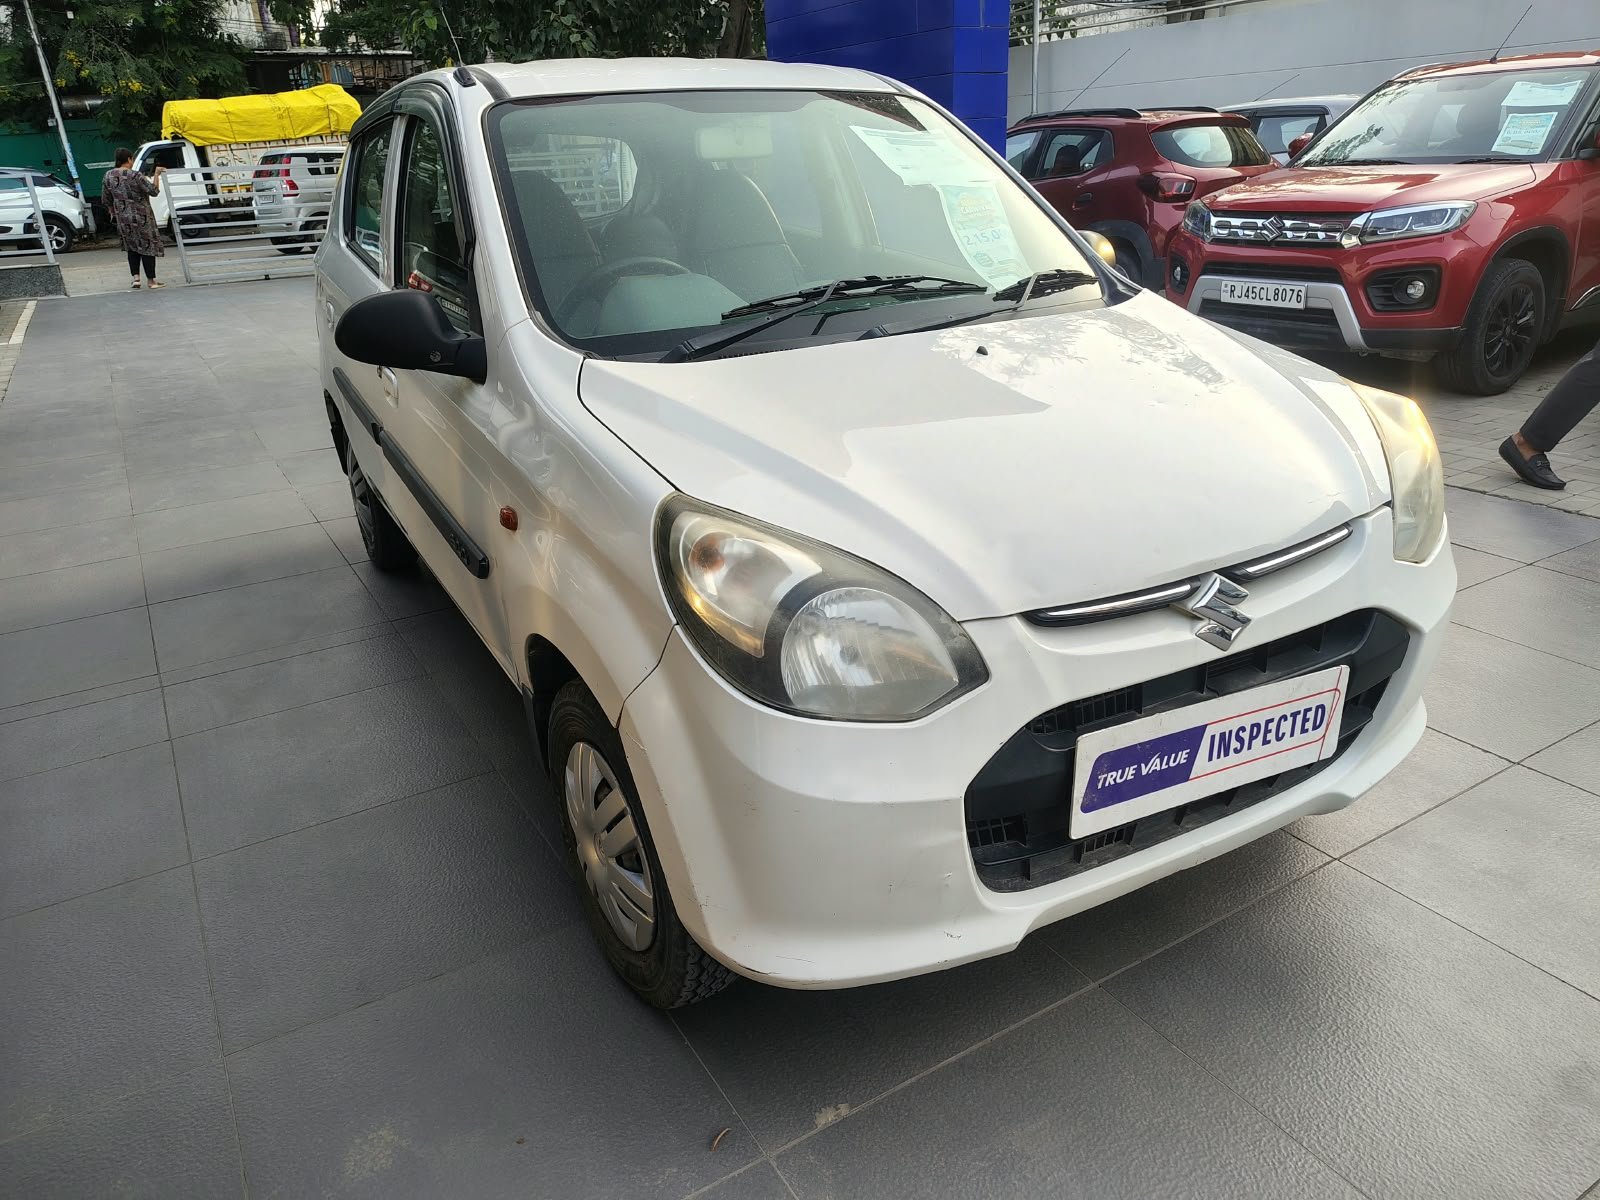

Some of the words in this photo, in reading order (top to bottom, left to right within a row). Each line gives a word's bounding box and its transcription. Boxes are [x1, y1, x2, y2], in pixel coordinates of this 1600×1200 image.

[1229, 284, 1303, 304] RJ45CL8076
[1097, 764, 1138, 790] TRUE
[1140, 748, 1190, 777] VALUE
[1207, 703, 1327, 763] INSPECTED
